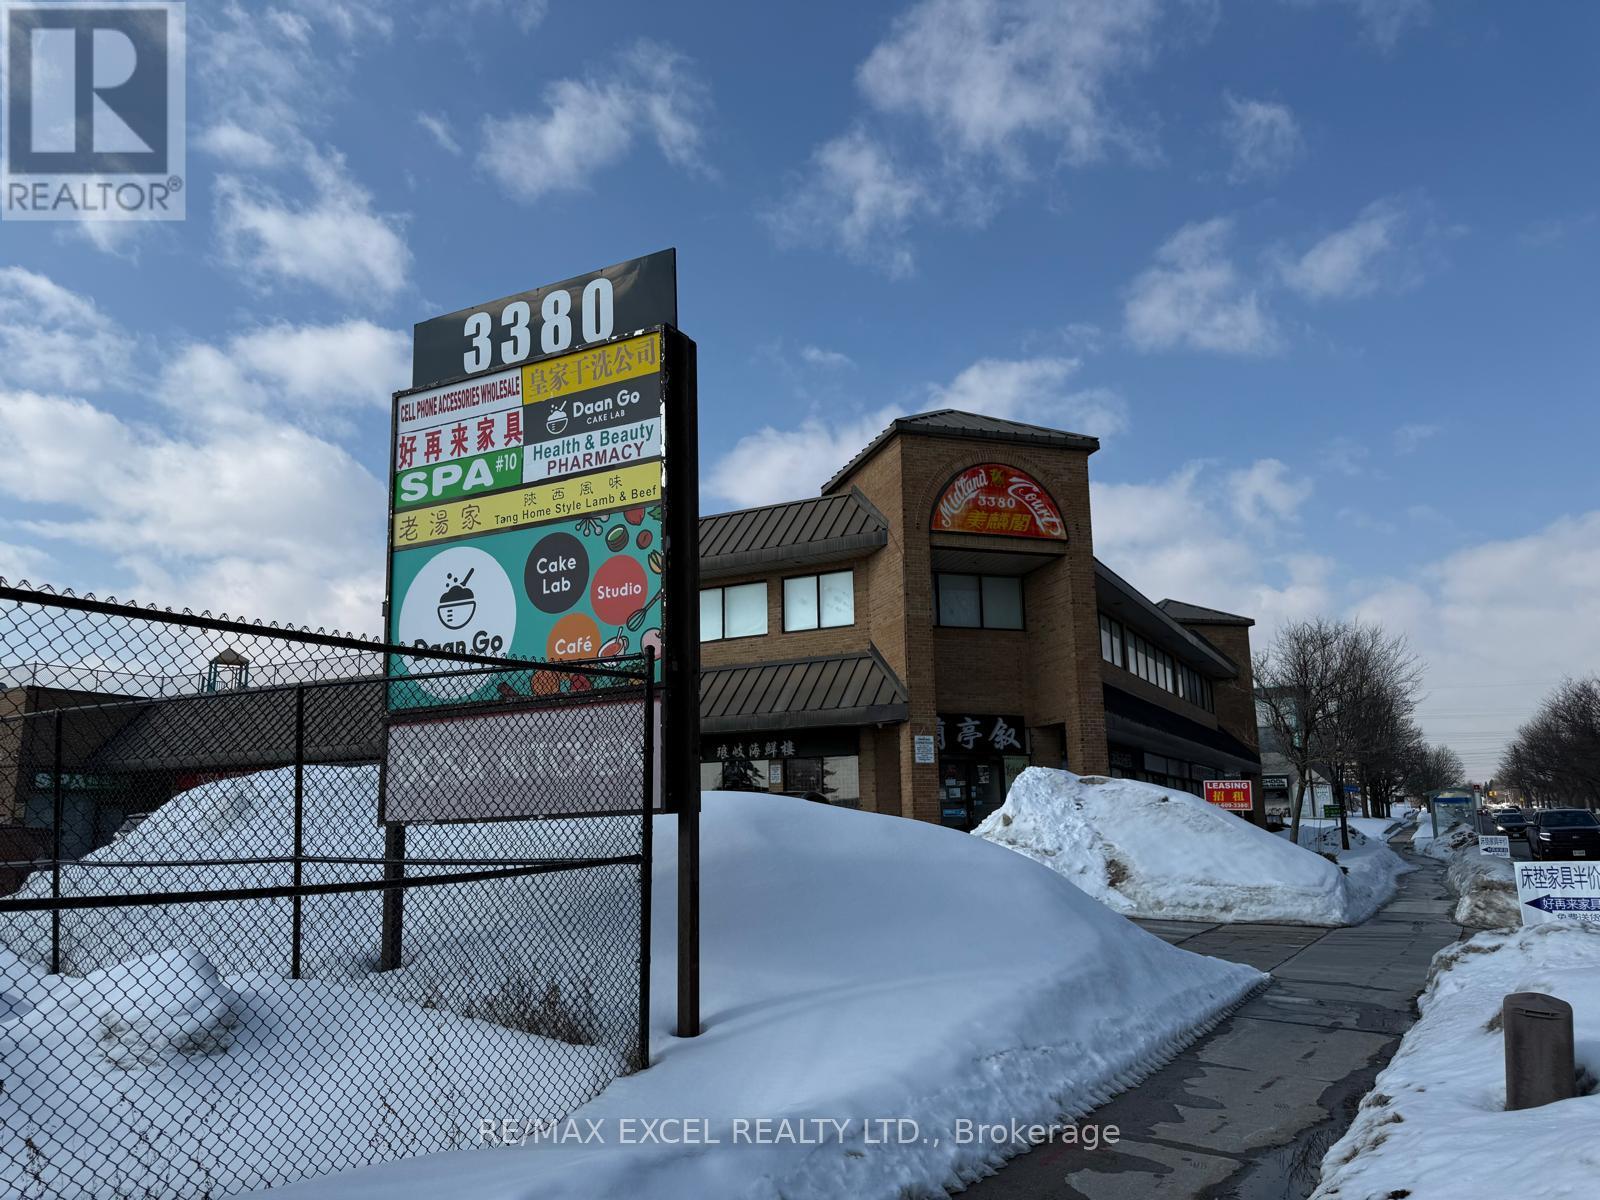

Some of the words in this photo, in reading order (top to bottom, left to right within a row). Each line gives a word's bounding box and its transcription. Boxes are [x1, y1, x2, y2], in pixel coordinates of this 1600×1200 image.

[464, 278, 614, 374] 3380
[400, 402, 415, 423] CELL
[417, 396, 438, 420] PHONE
[438, 386, 480, 414] ACCESSORIES
[480, 376, 520, 405] WHOLESALE
[573, 397, 613, 418] Daan
[616, 389, 640, 407] Go
[586, 413, 608, 425] CAKE
[610, 409, 625, 421] LAB
[399, 411, 523, 468] 好再来家具
[533, 437, 580, 461] Health
[585, 434, 595, 450] &
[600, 423, 654, 447] Beauty
[547, 441, 644, 475] PHARMACY
[400, 458, 494, 502] SPA
[495, 452, 517, 473] #10
[494, 513, 518, 526] Tang
[522, 507, 551, 520] Home
[555, 501, 582, 517] Style
[586, 494, 615, 508] Lamb
[619, 491, 627, 502] &
[631, 485, 657, 499] Beef
[940, 468, 989, 528] Midland
[1007, 476, 1062, 535] Court
[978, 495, 1016, 509] 3380
[399, 504, 482, 541] 老湯家
[536, 556, 577, 575] Cake
[543, 577, 571, 595] Lab
[597, 582, 642, 600] Studio
[472, 630, 504, 654] Go
[555, 636, 593, 655] Café
[1520, 865, 1600, 890] 床垫家具半价
